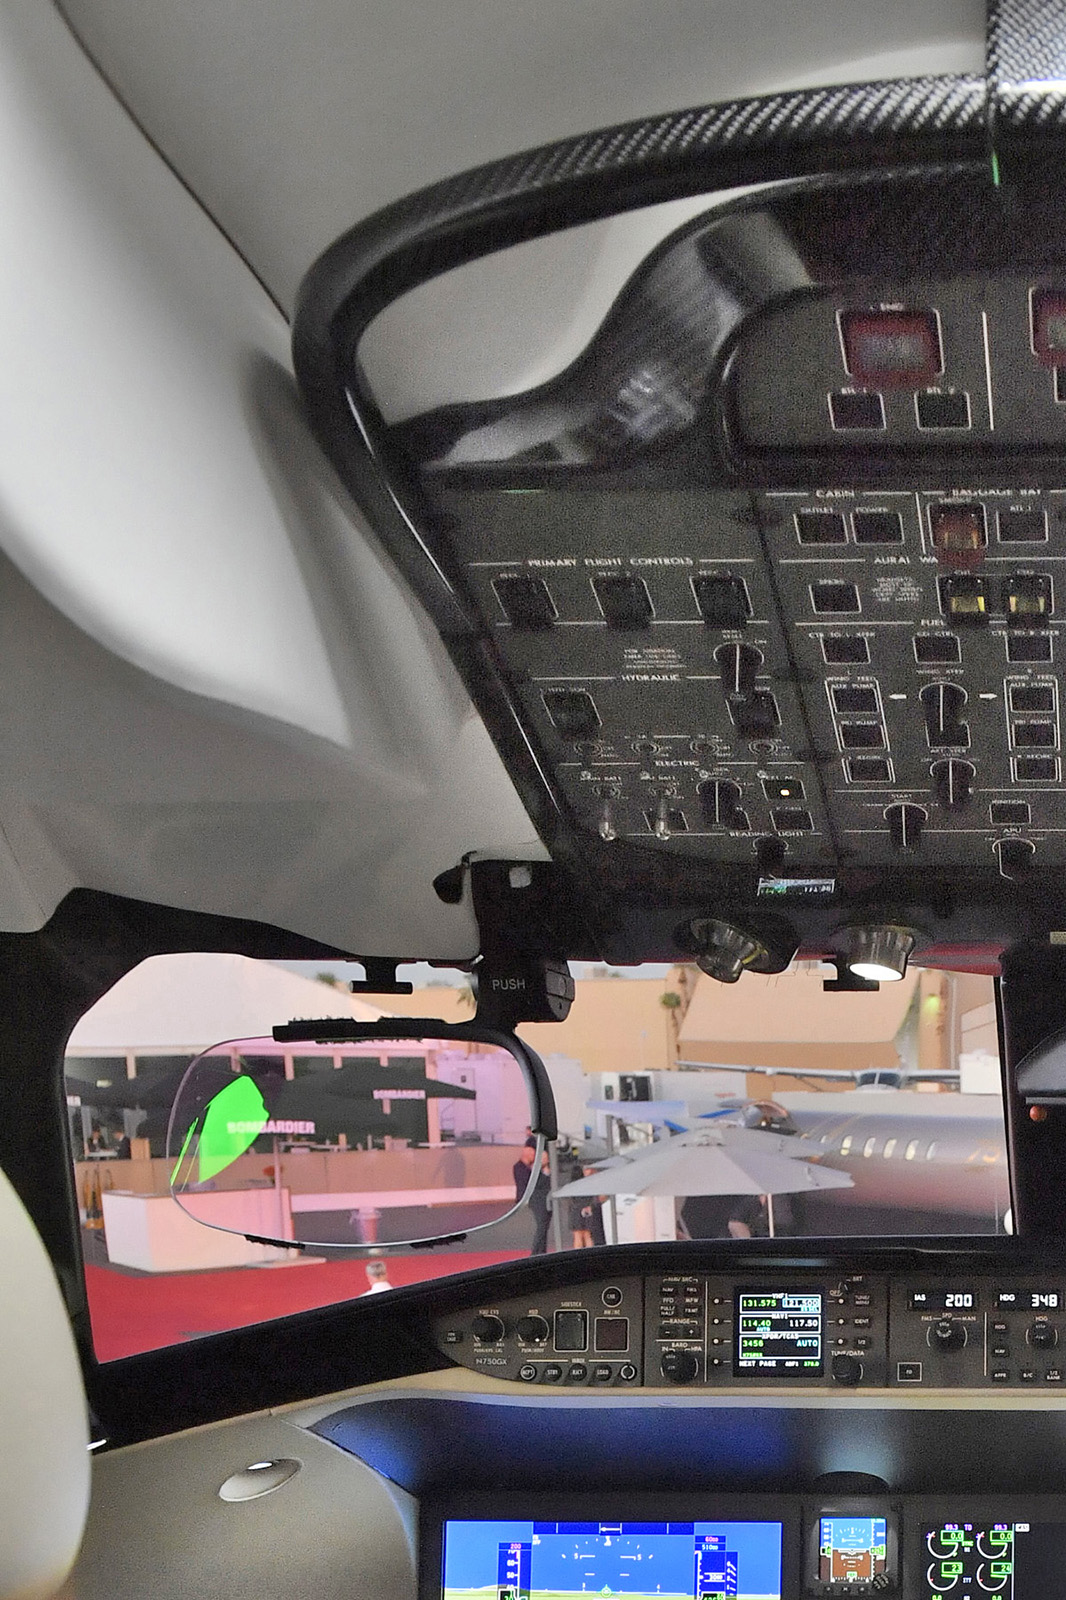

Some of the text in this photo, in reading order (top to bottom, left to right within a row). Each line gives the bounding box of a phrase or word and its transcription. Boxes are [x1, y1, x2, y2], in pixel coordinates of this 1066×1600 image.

[492, 979, 526, 991] PUSH
[743, 1299, 777, 1308] 131.575
[945, 1293, 973, 1308] 200
[1031, 1293, 1058, 1308] 348
[743, 1320, 818, 1328] 114.40 117.50
[796, 1339, 818, 1348] AUTO
